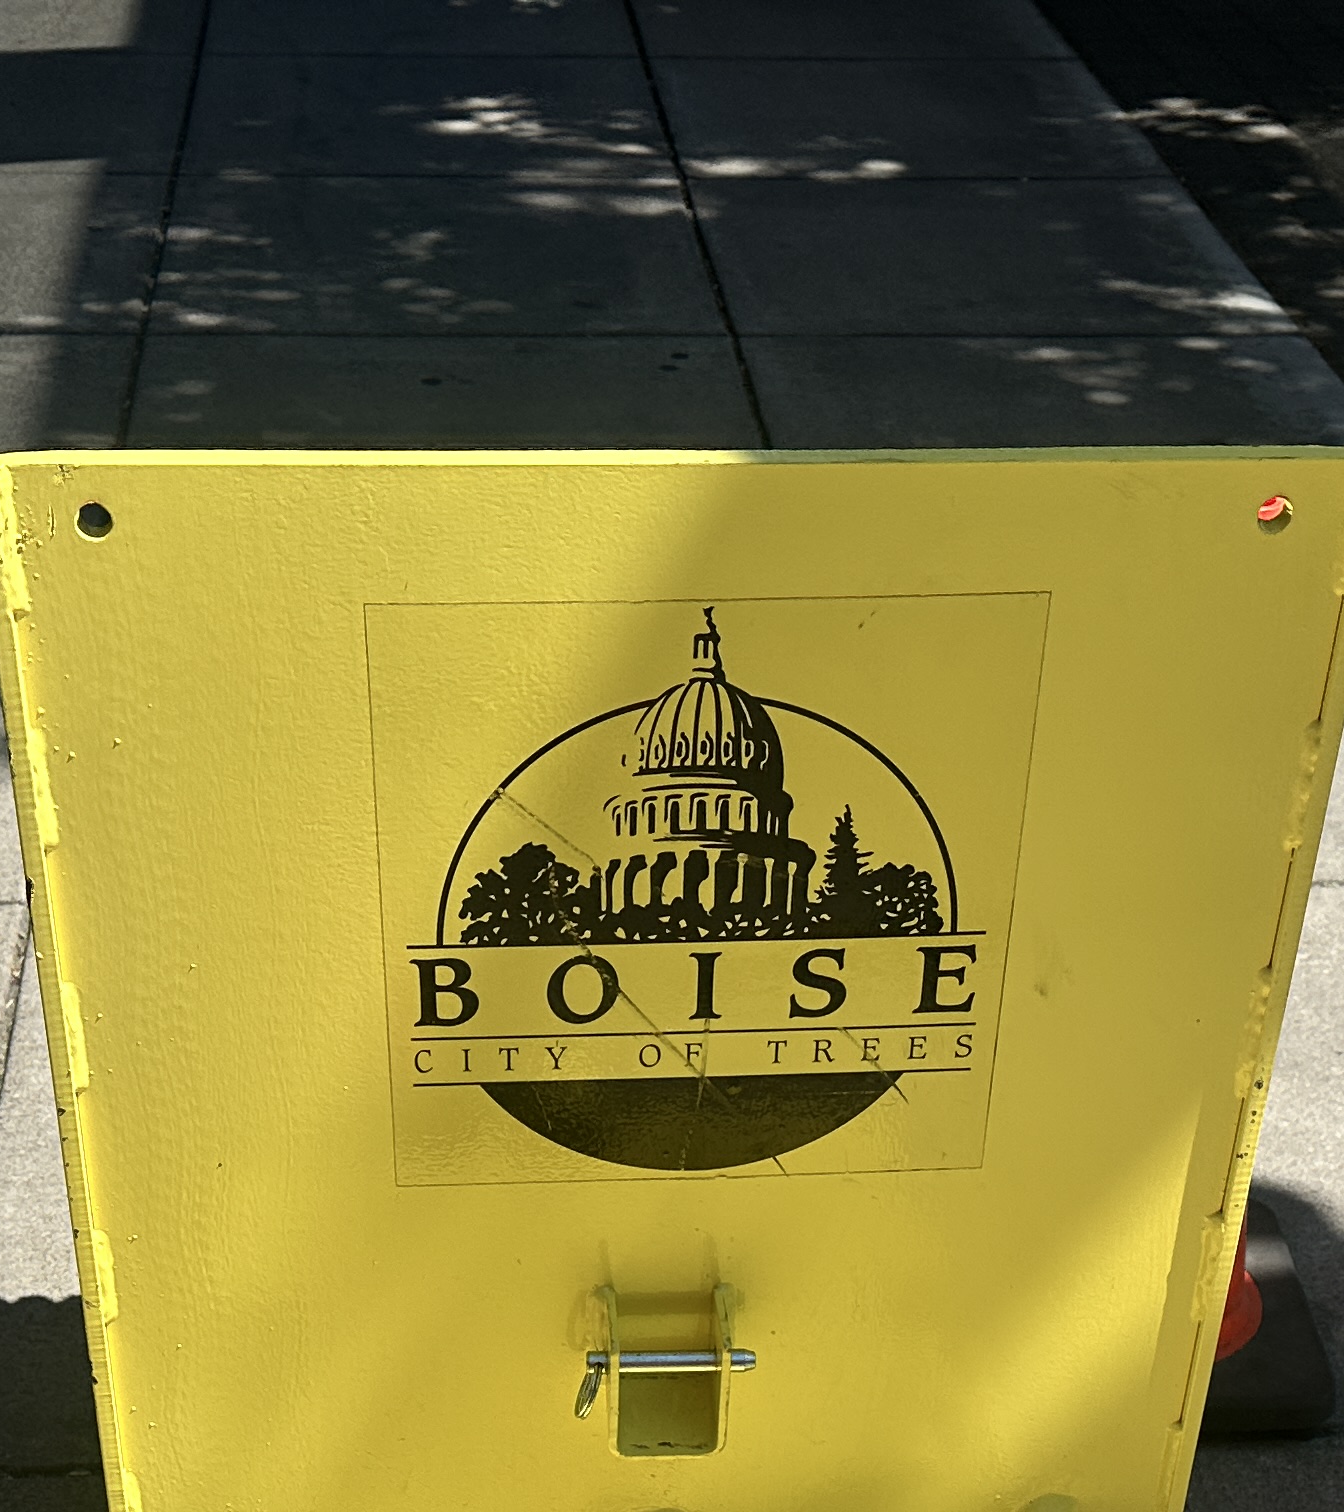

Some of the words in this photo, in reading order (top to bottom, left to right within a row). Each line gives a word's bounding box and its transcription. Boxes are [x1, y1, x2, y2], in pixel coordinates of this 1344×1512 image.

[410, 944, 977, 1027] BOISE
[414, 1046, 568, 1073] CITY
[639, 1043, 704, 1068] OF
[767, 1034, 974, 1065] TREES
